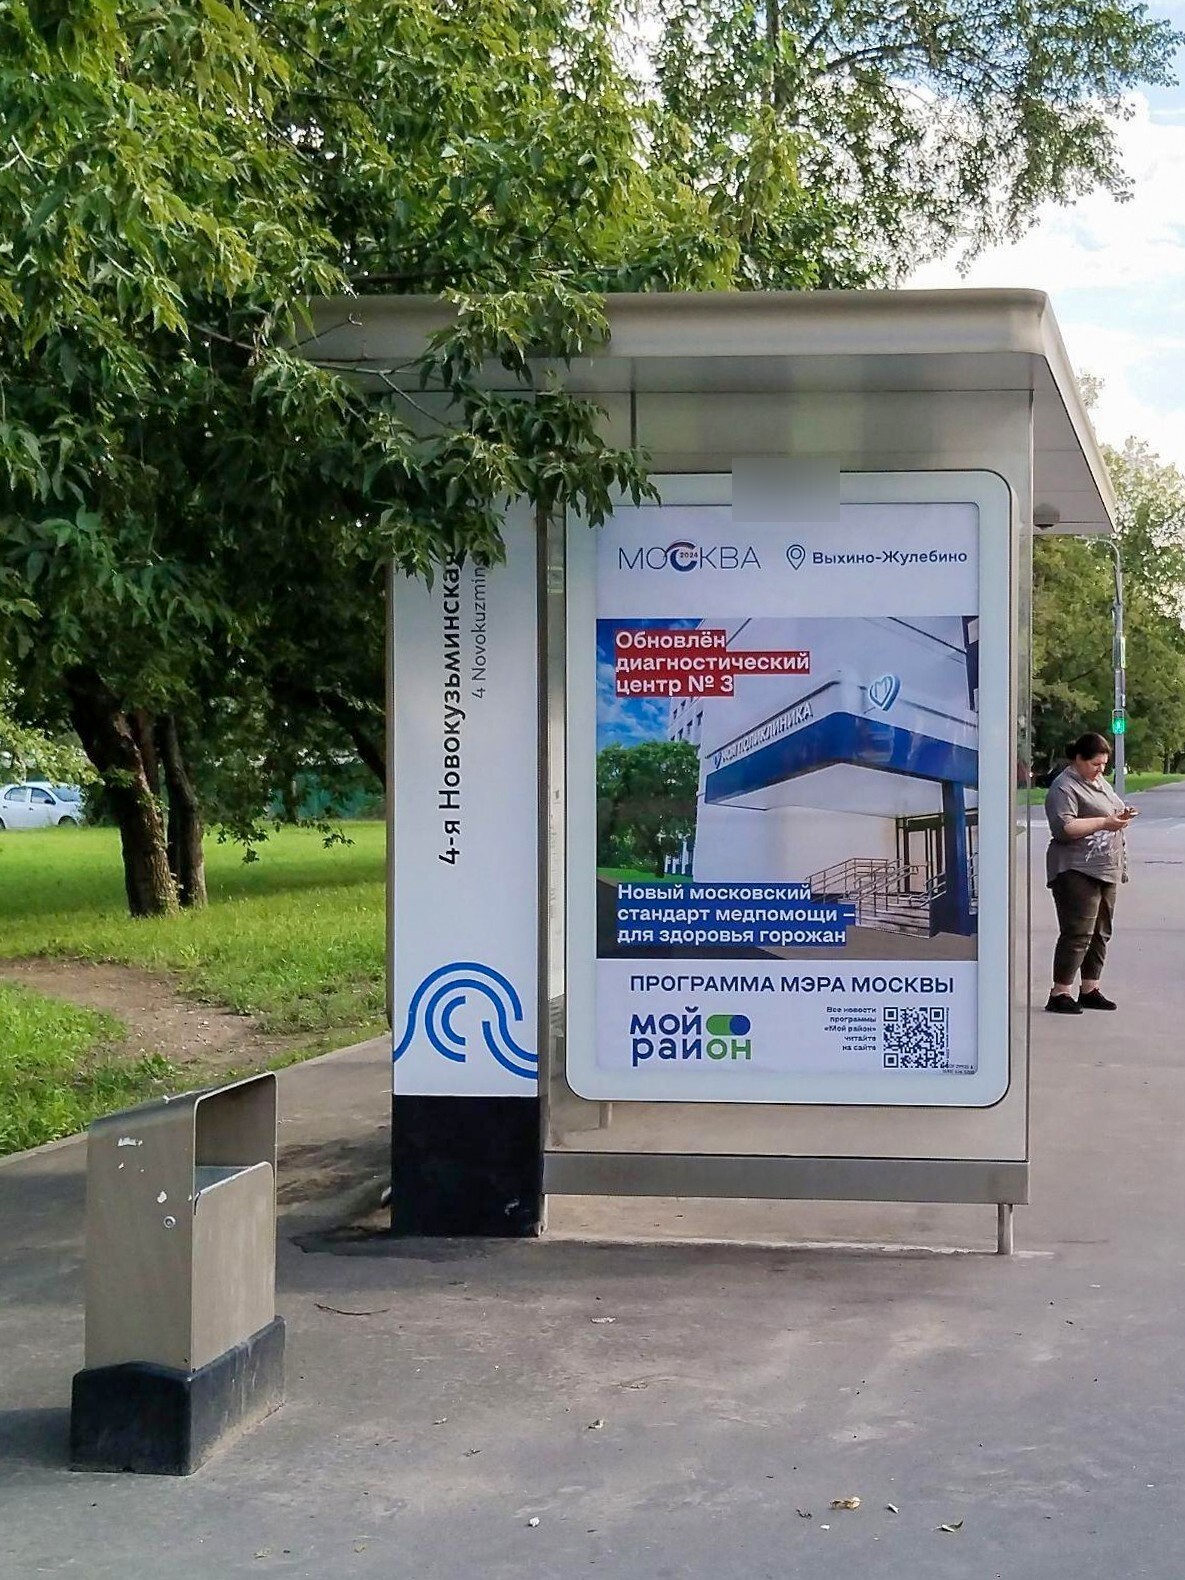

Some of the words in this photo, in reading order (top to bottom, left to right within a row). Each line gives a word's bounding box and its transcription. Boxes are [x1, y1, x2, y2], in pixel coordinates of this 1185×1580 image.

[618, 540, 762, 572] МОСКВА
[679, 551, 699, 559] 2024
[812, 550, 968, 566] Выхино-Жулебино
[616, 631, 725, 649] Обновлён
[616, 651, 809, 673] диагностический
[471, 687, 487, 700] 4
[617, 679, 682, 696] центр
[688, 675, 715, 692] №
[720, 675, 734, 692] 3
[438, 820, 462, 865] 4-я
[618, 883, 684, 900] Новый
[690, 883, 811, 900] московский
[617, 908, 710, 925] стандарт
[716, 909, 837, 925] медпомощи
[617, 930, 654, 944] для
[660, 930, 754, 946] здоровья
[760, 930, 846, 946] горожан
[630, 975, 776, 993] ПРОГРАММА
[780, 976, 846, 993] МЭРА
[851, 976, 954, 994] МОСКВЫ
[843, 1006, 877, 1014] новости
[630, 1005, 702, 1036] мой
